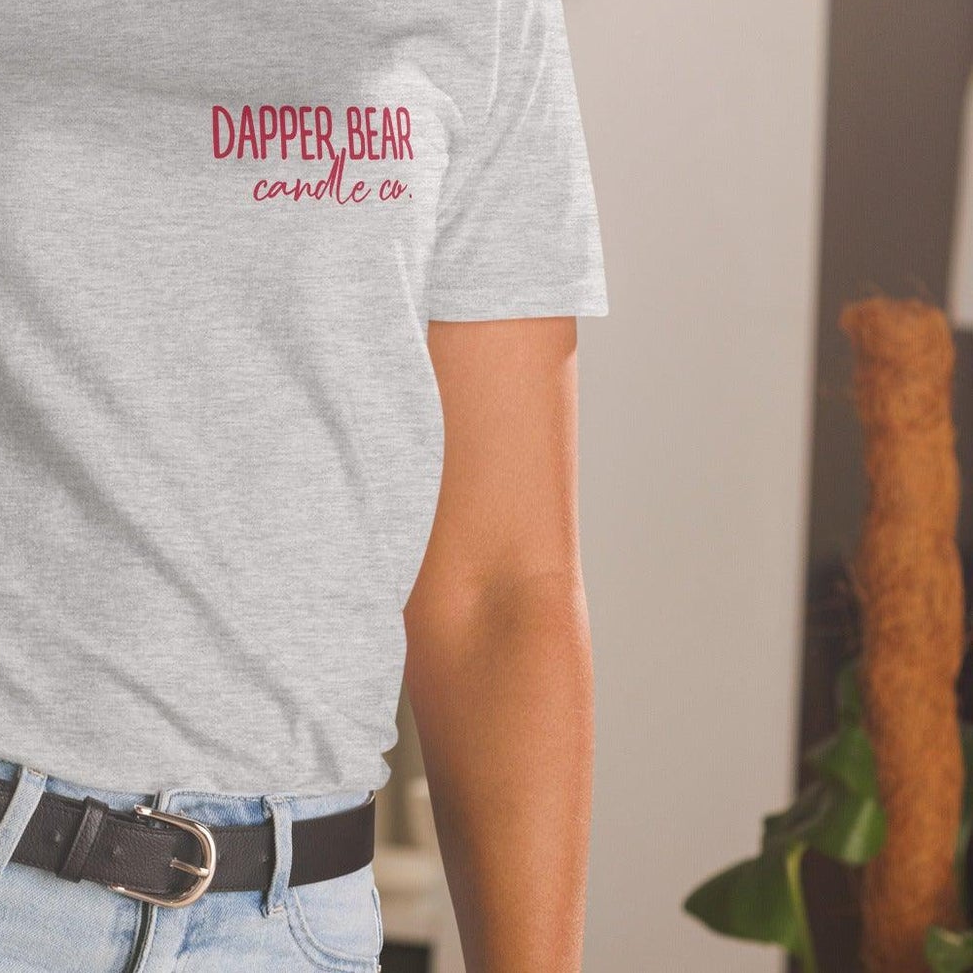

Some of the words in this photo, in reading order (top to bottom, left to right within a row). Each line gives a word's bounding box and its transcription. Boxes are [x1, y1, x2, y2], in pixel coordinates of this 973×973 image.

[212, 104, 335, 160] DAPPER
[346, 105, 414, 161] BEAR
[253, 147, 371, 204] candle
[378, 179, 413, 201] co.
